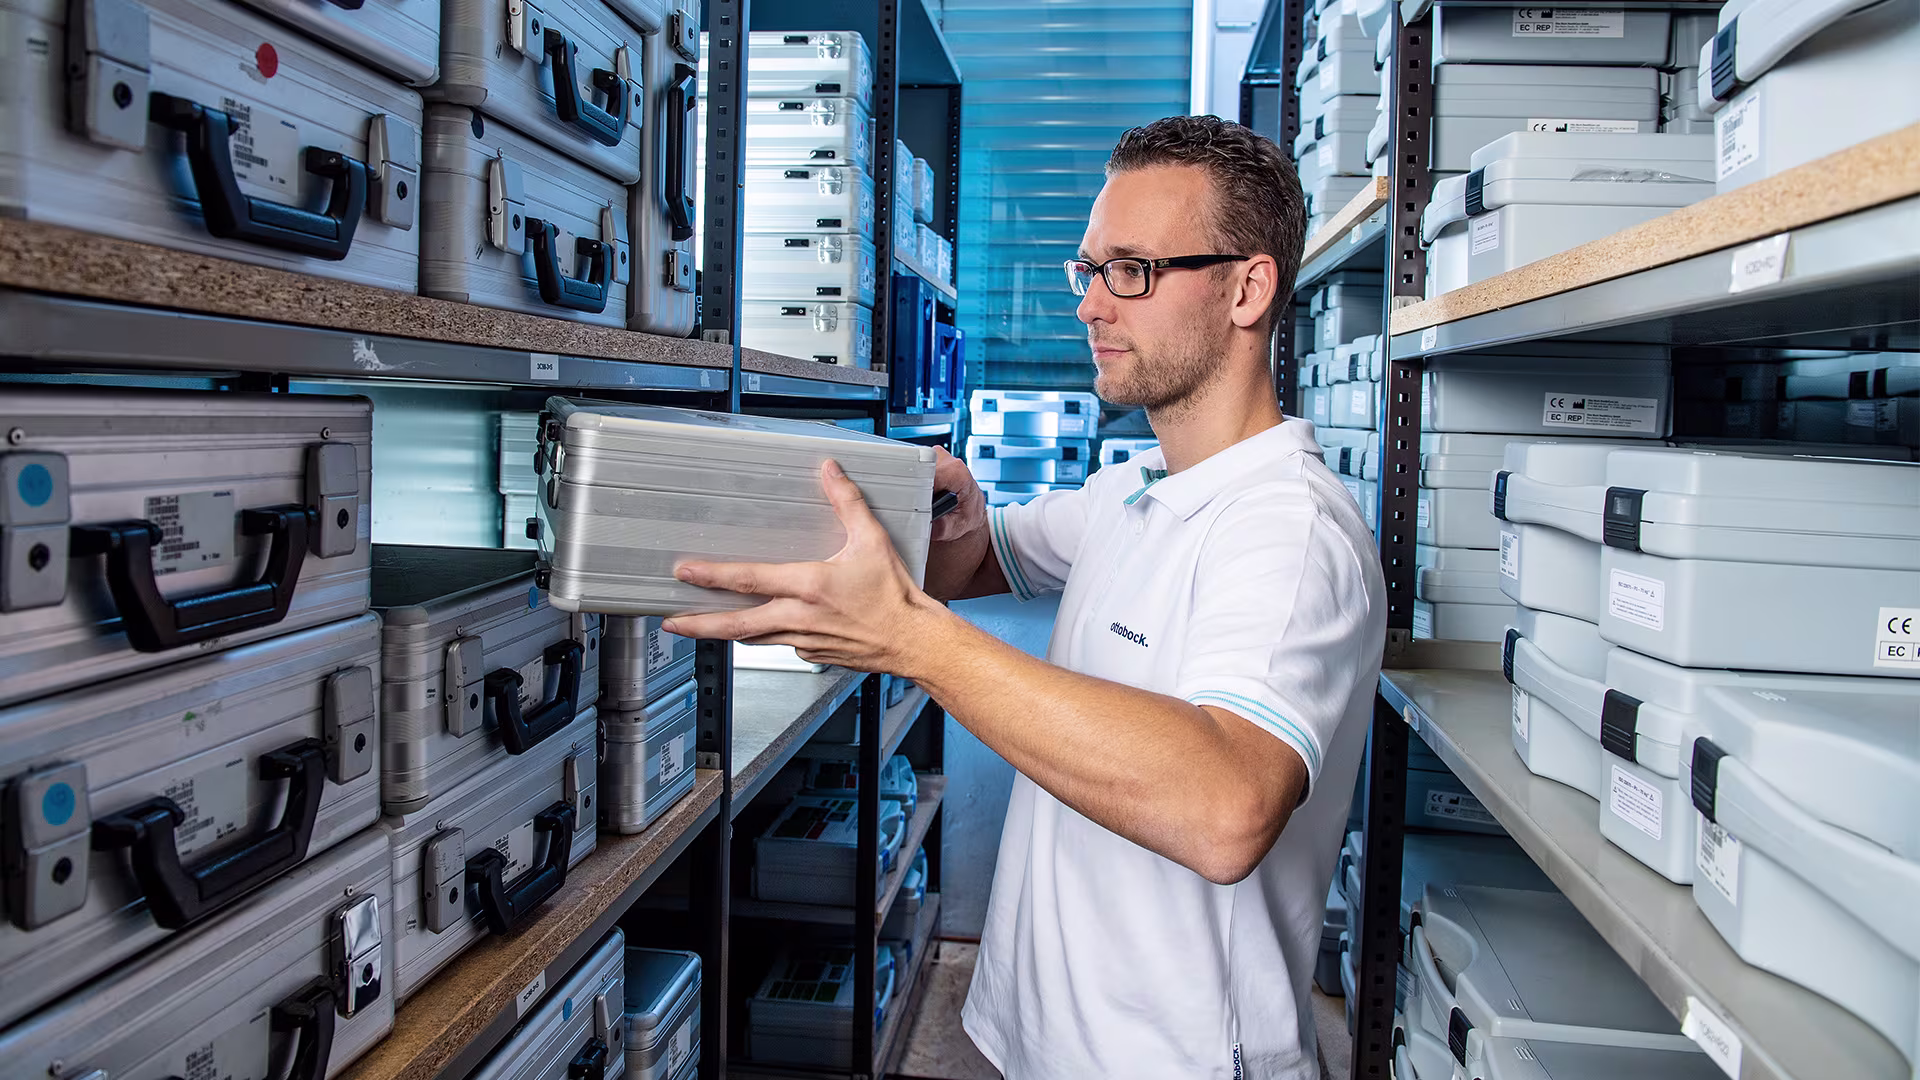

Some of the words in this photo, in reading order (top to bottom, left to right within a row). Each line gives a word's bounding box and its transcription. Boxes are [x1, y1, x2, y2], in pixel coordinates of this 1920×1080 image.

[1550, 397, 1565, 409] CE
[1551, 413, 1561, 421] EC
[1567, 414, 1582, 422] REP
[1887, 616, 1912, 635] CE
[1888, 645, 1906, 657] EC
[1233, 1044, 1242, 1080] ttobock.
